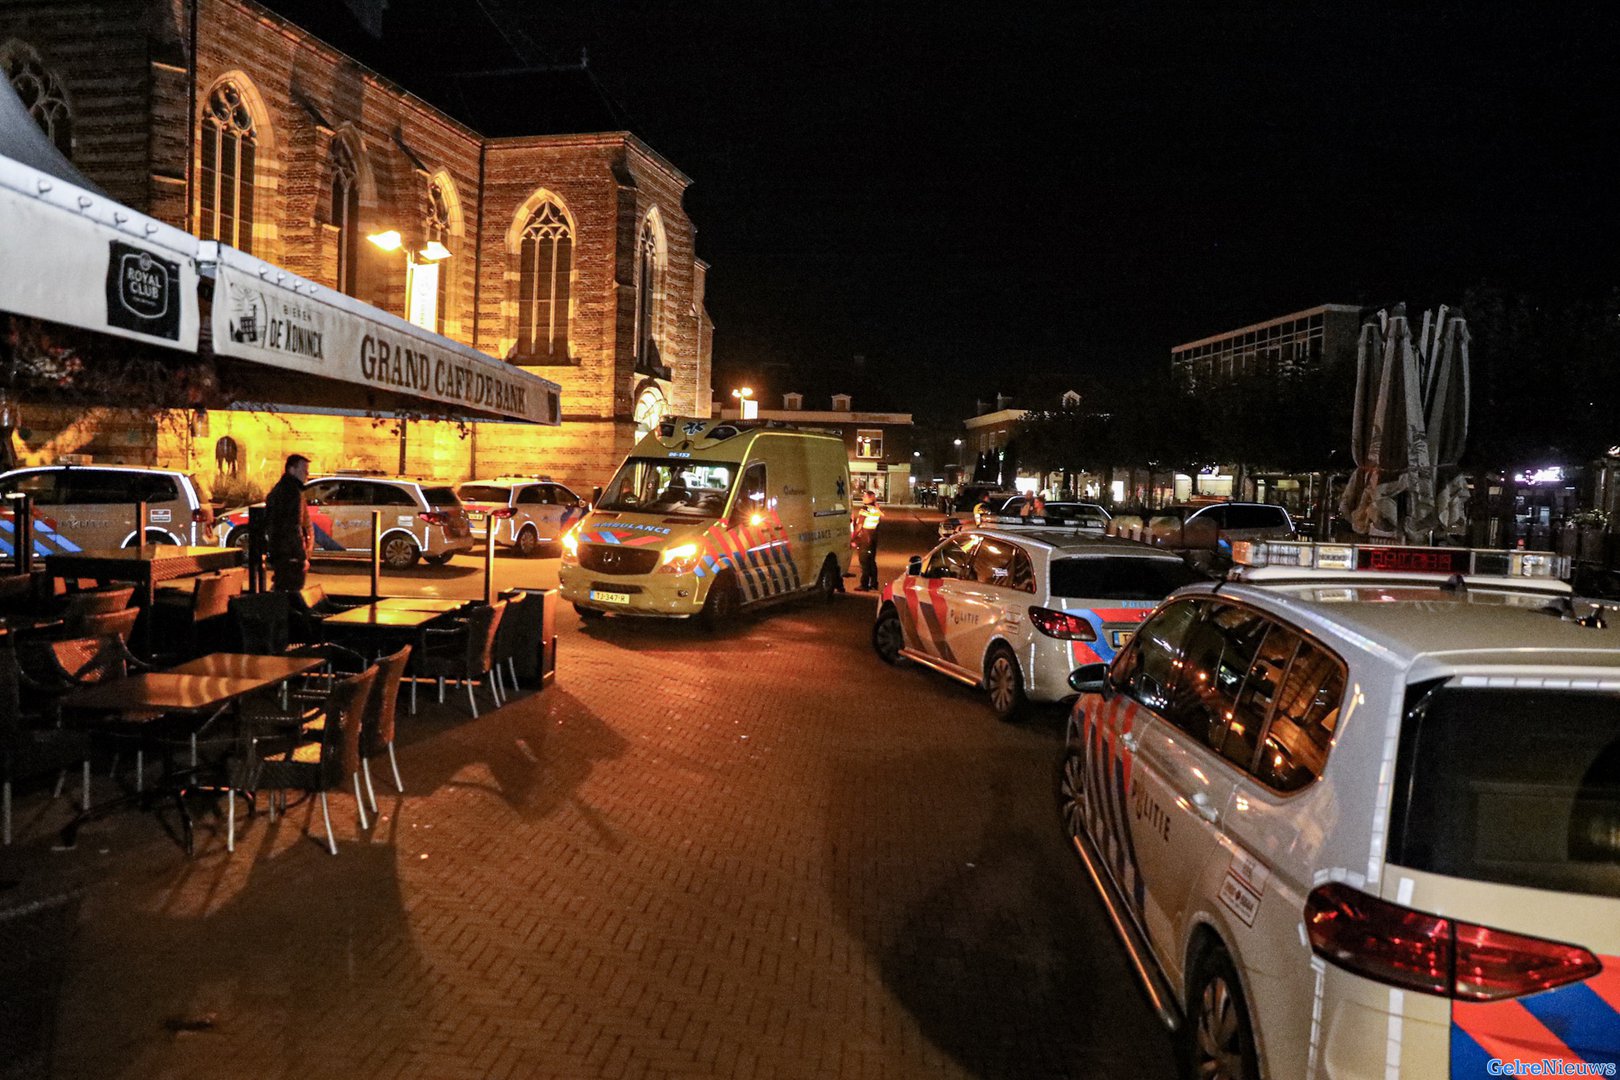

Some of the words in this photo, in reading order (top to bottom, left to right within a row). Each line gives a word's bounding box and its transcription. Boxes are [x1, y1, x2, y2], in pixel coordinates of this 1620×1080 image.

[127, 266, 162, 288] ROYAL
[129, 281, 159, 299] CLUB
[270, 317, 283, 348] DE
[284, 319, 324, 360] KONINCK
[360, 334, 430, 392] GRAND
[474, 373, 493, 407] DE
[495, 379, 526, 415] BANK
[592, 522, 672, 535] AMBULANCE
[950, 609, 980, 625] POLITIE
[1131, 779, 1171, 842] POLITIE
